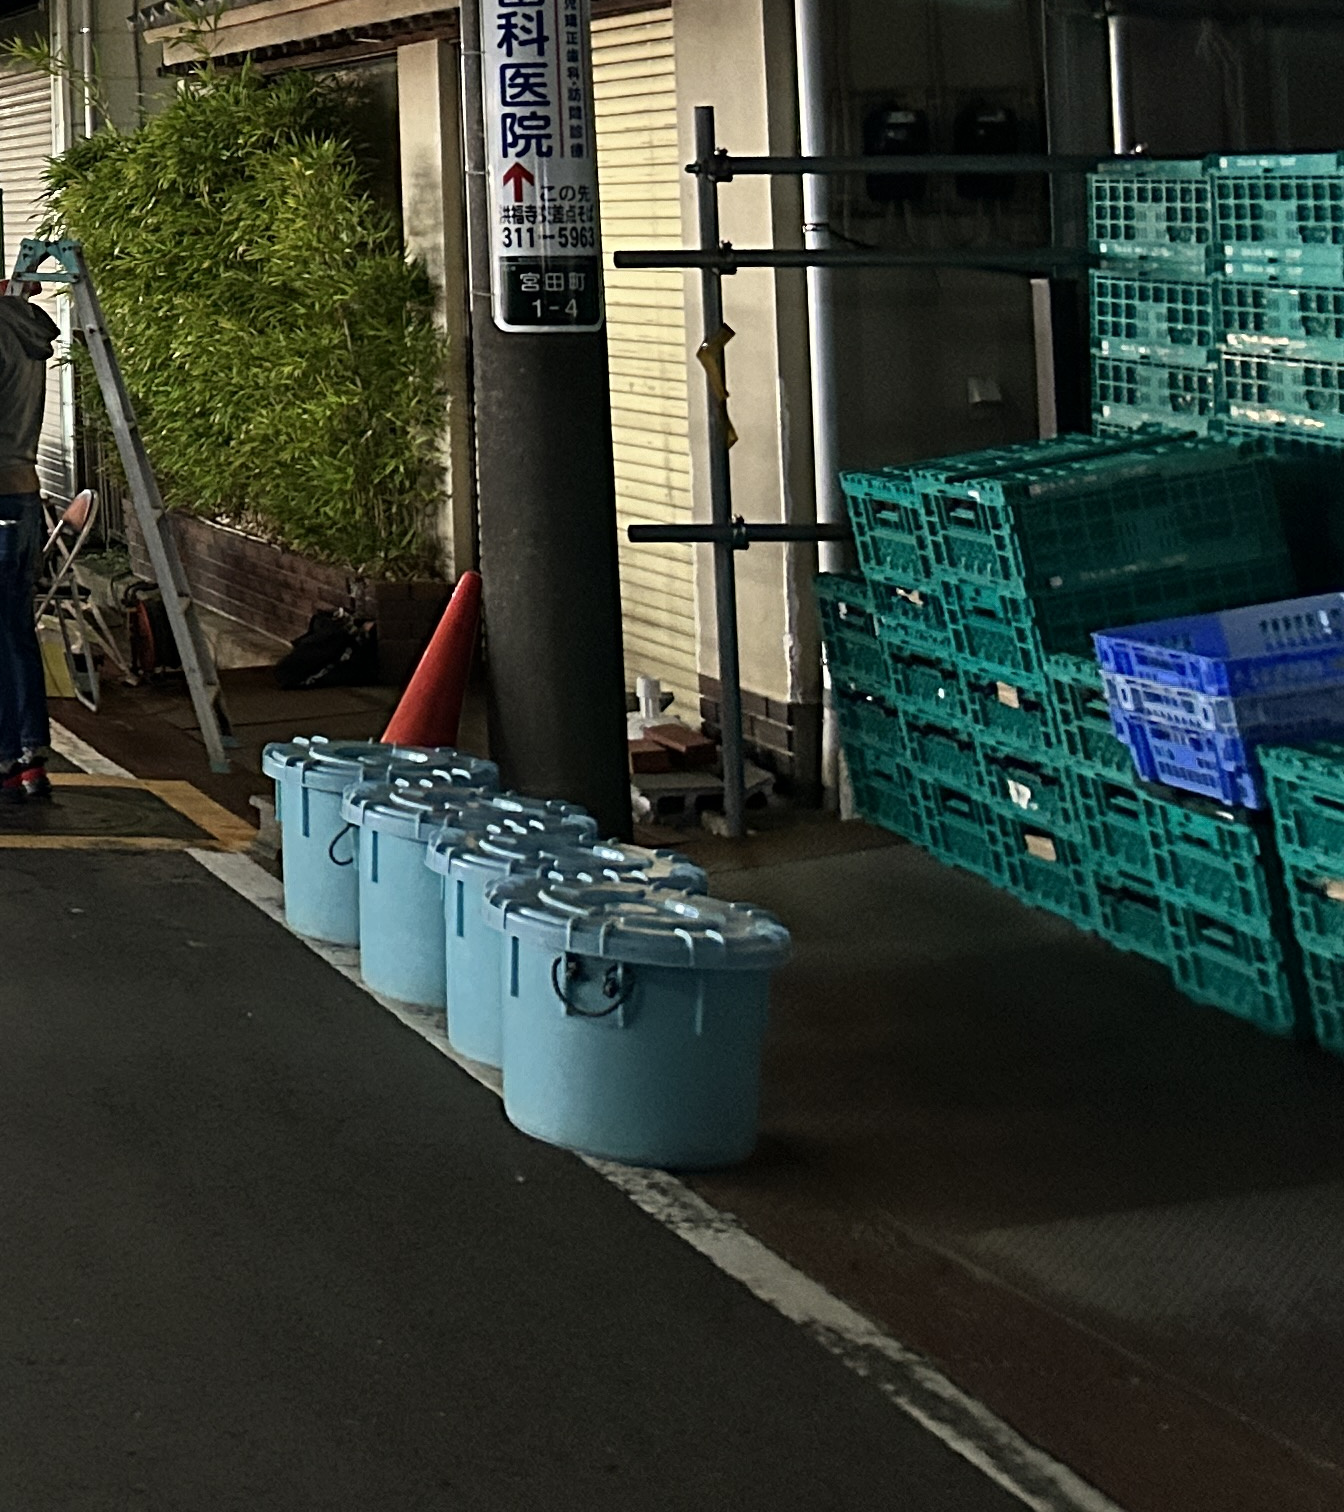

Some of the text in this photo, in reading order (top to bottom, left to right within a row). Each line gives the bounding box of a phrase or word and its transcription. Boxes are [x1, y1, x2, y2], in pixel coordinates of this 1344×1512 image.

[540, 185, 592, 203] この先
[502, 226, 595, 248] 311-5963
[519, 272, 586, 292] 宮田町
[531, 298, 578, 318] 1-4
